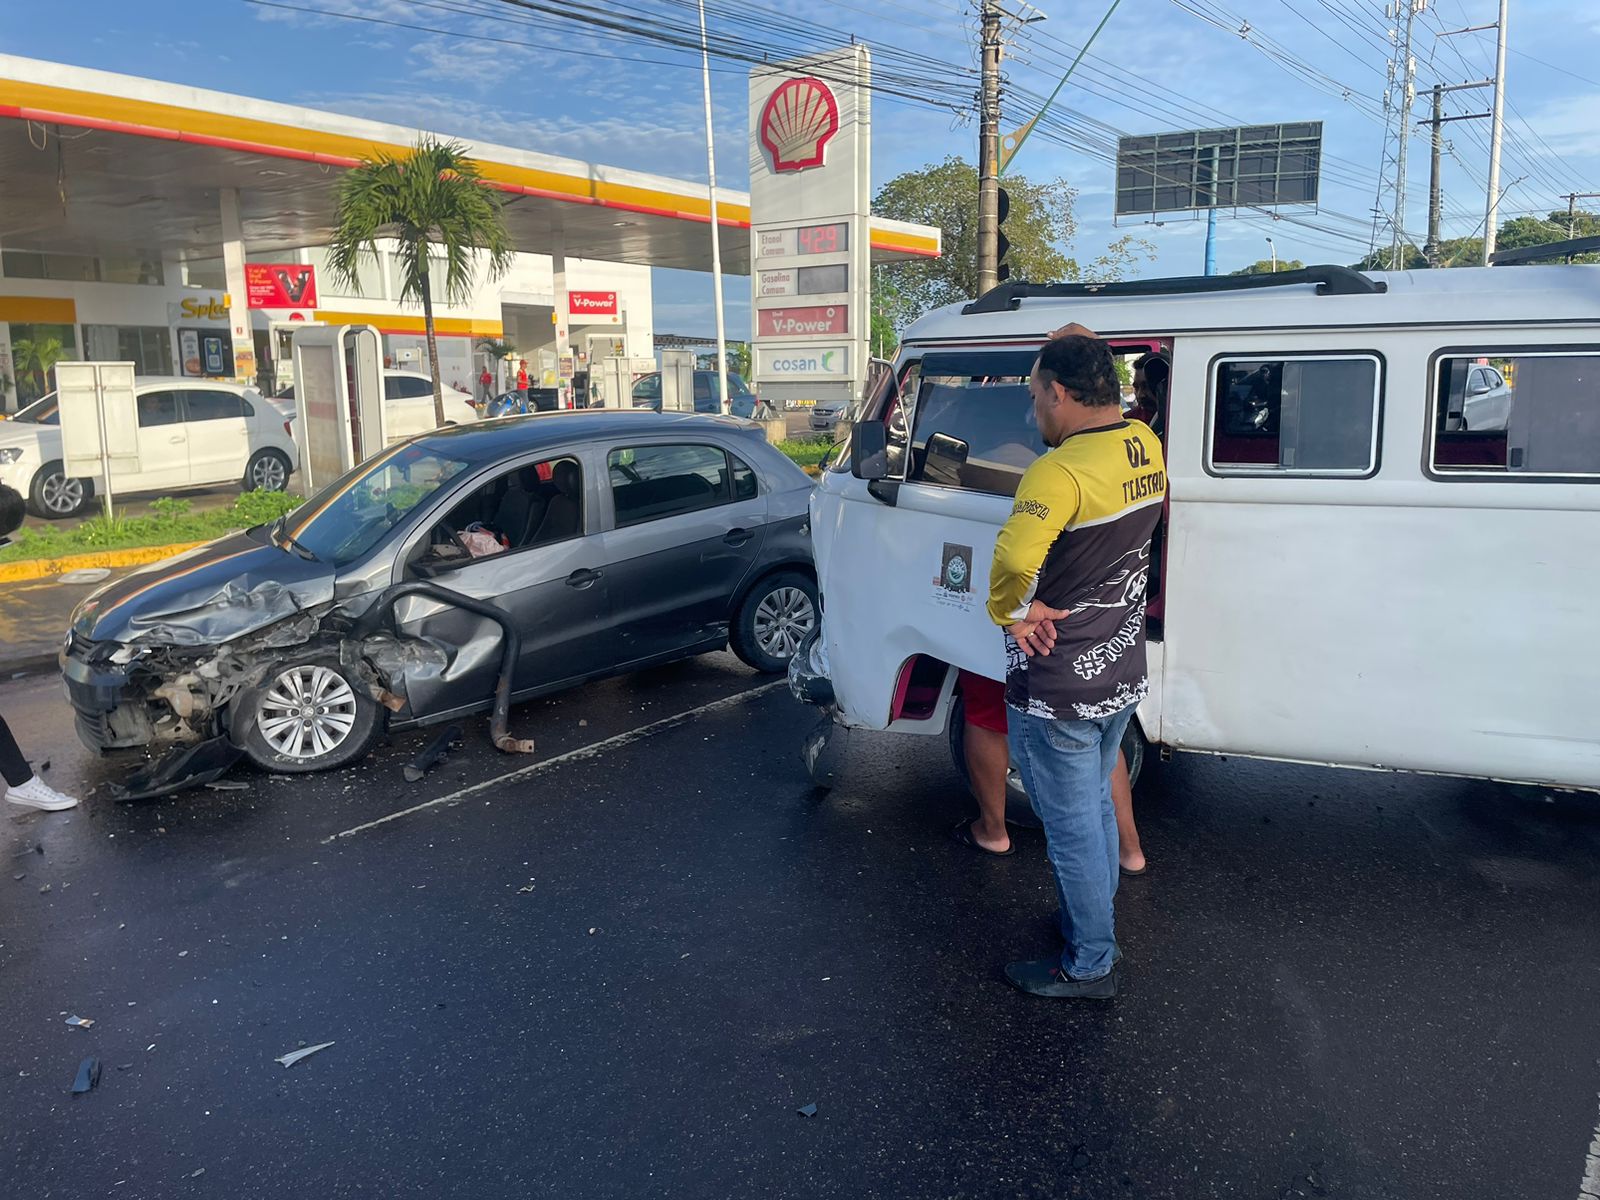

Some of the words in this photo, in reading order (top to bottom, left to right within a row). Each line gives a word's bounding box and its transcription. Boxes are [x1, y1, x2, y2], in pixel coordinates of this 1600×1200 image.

[761, 232, 783, 245] Etanol
[761, 271, 791, 283] Gasolina
[761, 284, 786, 295] Comum
[573, 298, 614, 308] V-Power
[772, 318, 833, 333] V-Power
[773, 357, 817, 371] cosan
[1123, 435, 1151, 469] 02
